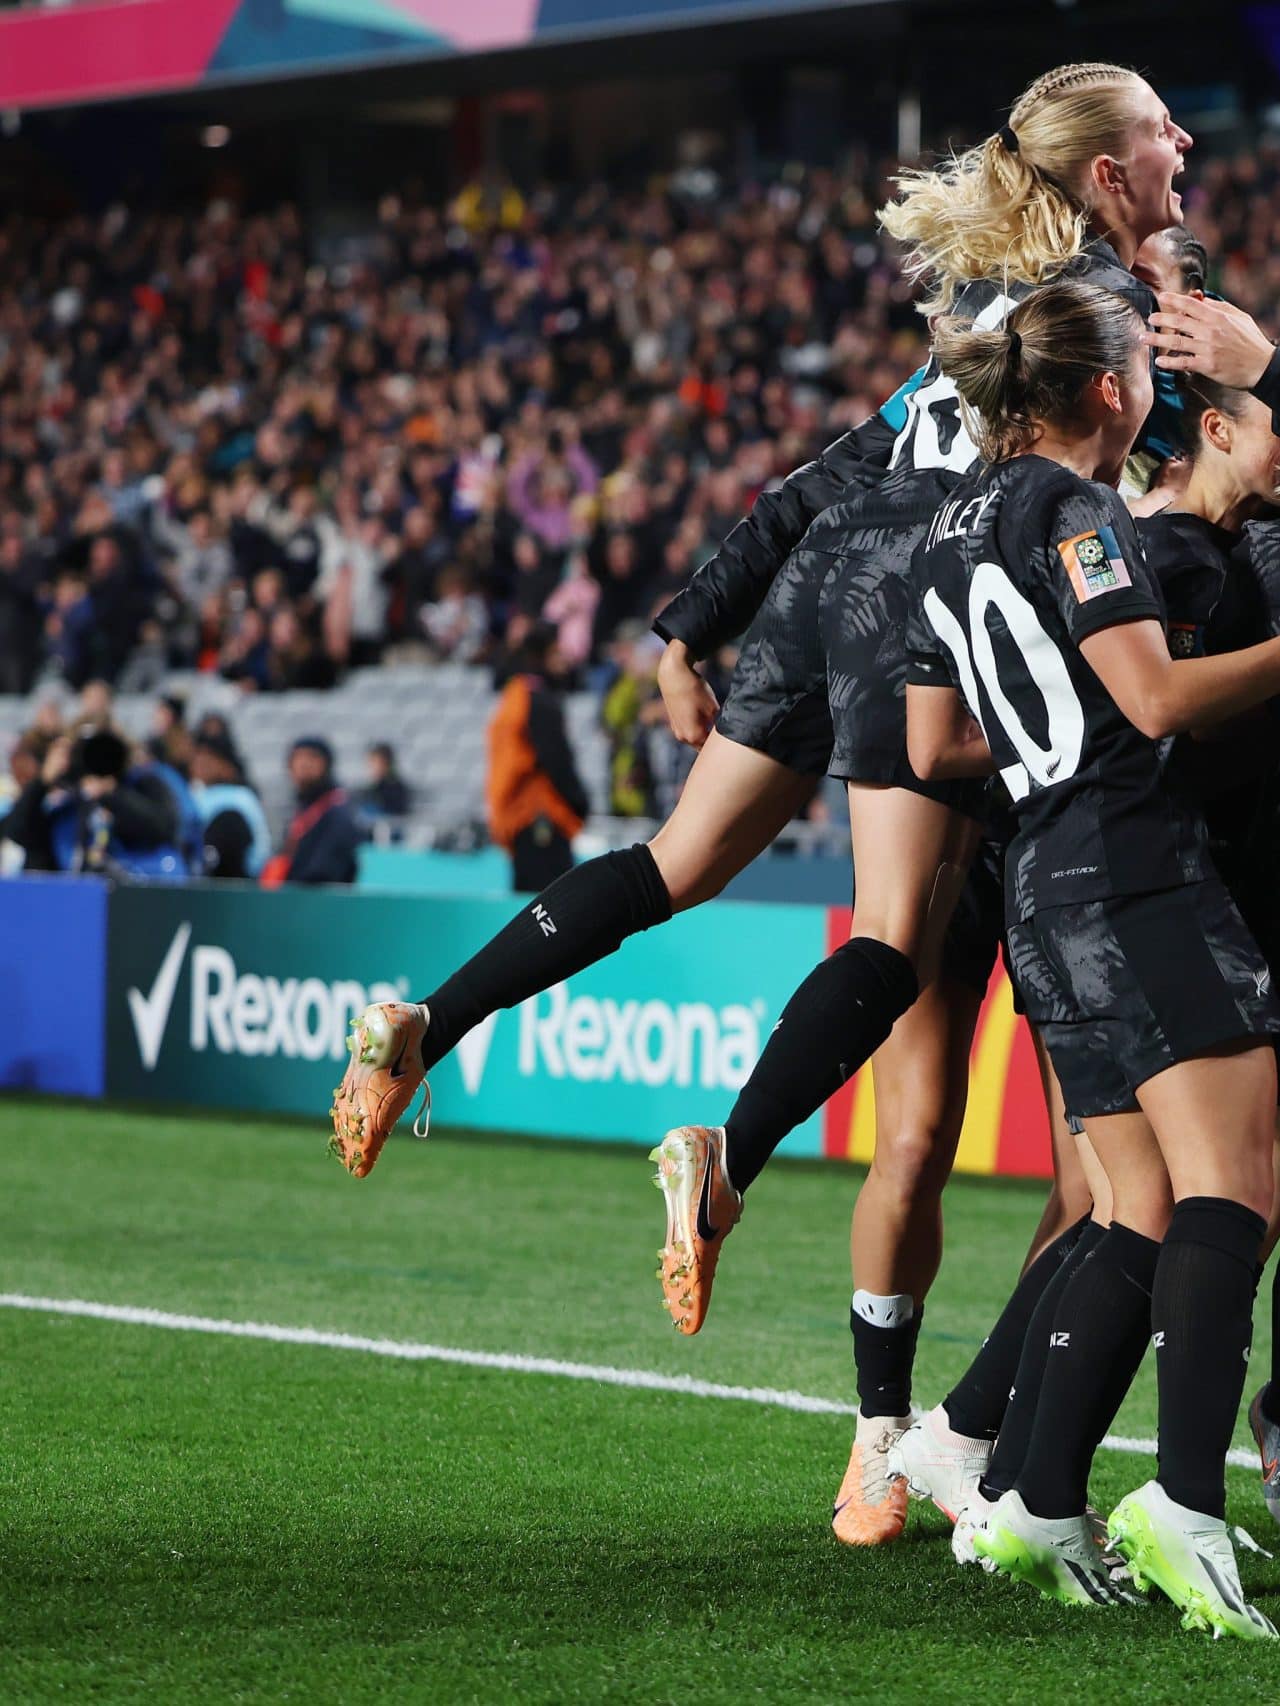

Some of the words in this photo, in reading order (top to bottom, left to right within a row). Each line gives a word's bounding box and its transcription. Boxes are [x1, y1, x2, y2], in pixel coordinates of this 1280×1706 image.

[923, 562, 1085, 804] 10
[531, 904, 557, 937] NZ
[518, 980, 762, 1092] Rexona
